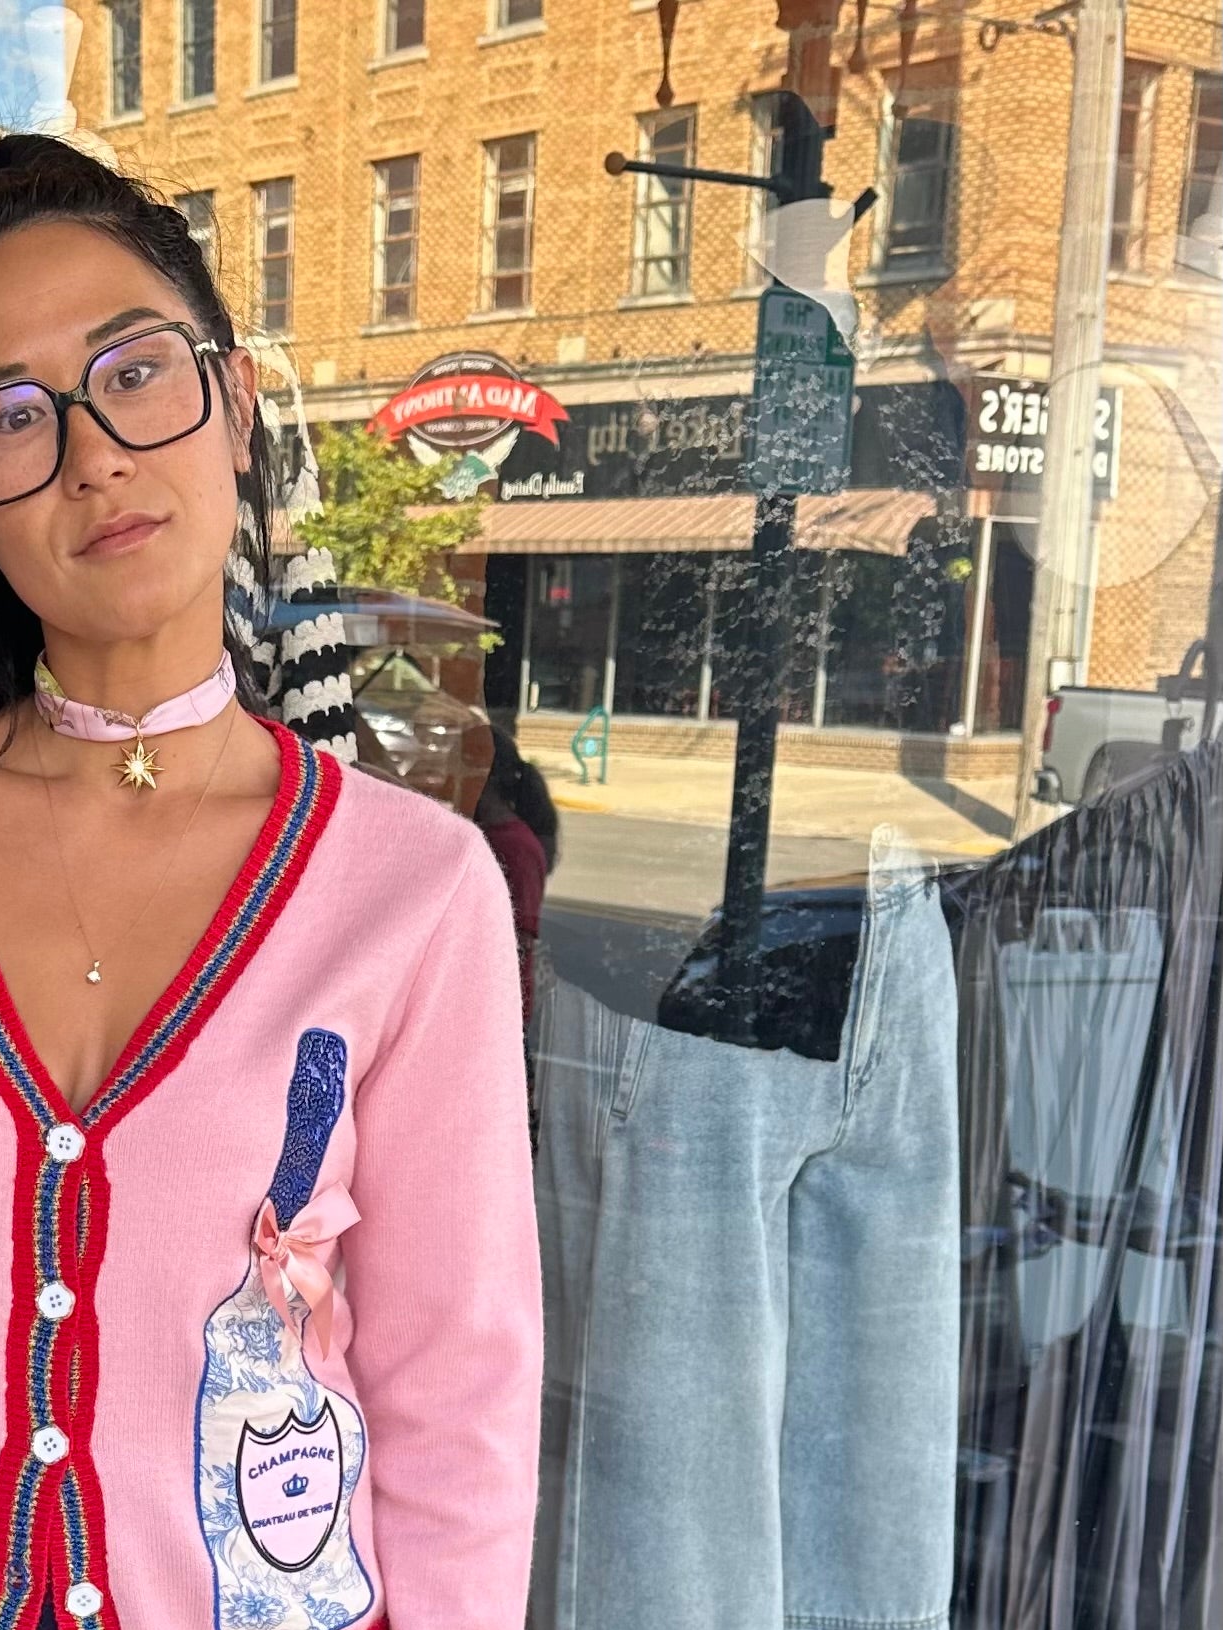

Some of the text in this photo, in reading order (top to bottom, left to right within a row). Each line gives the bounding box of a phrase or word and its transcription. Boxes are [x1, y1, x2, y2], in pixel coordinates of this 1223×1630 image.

[248, 1447, 335, 1480] CHAMPAGNE
[251, 1502, 334, 1529] CHATEAU DE ROSE
